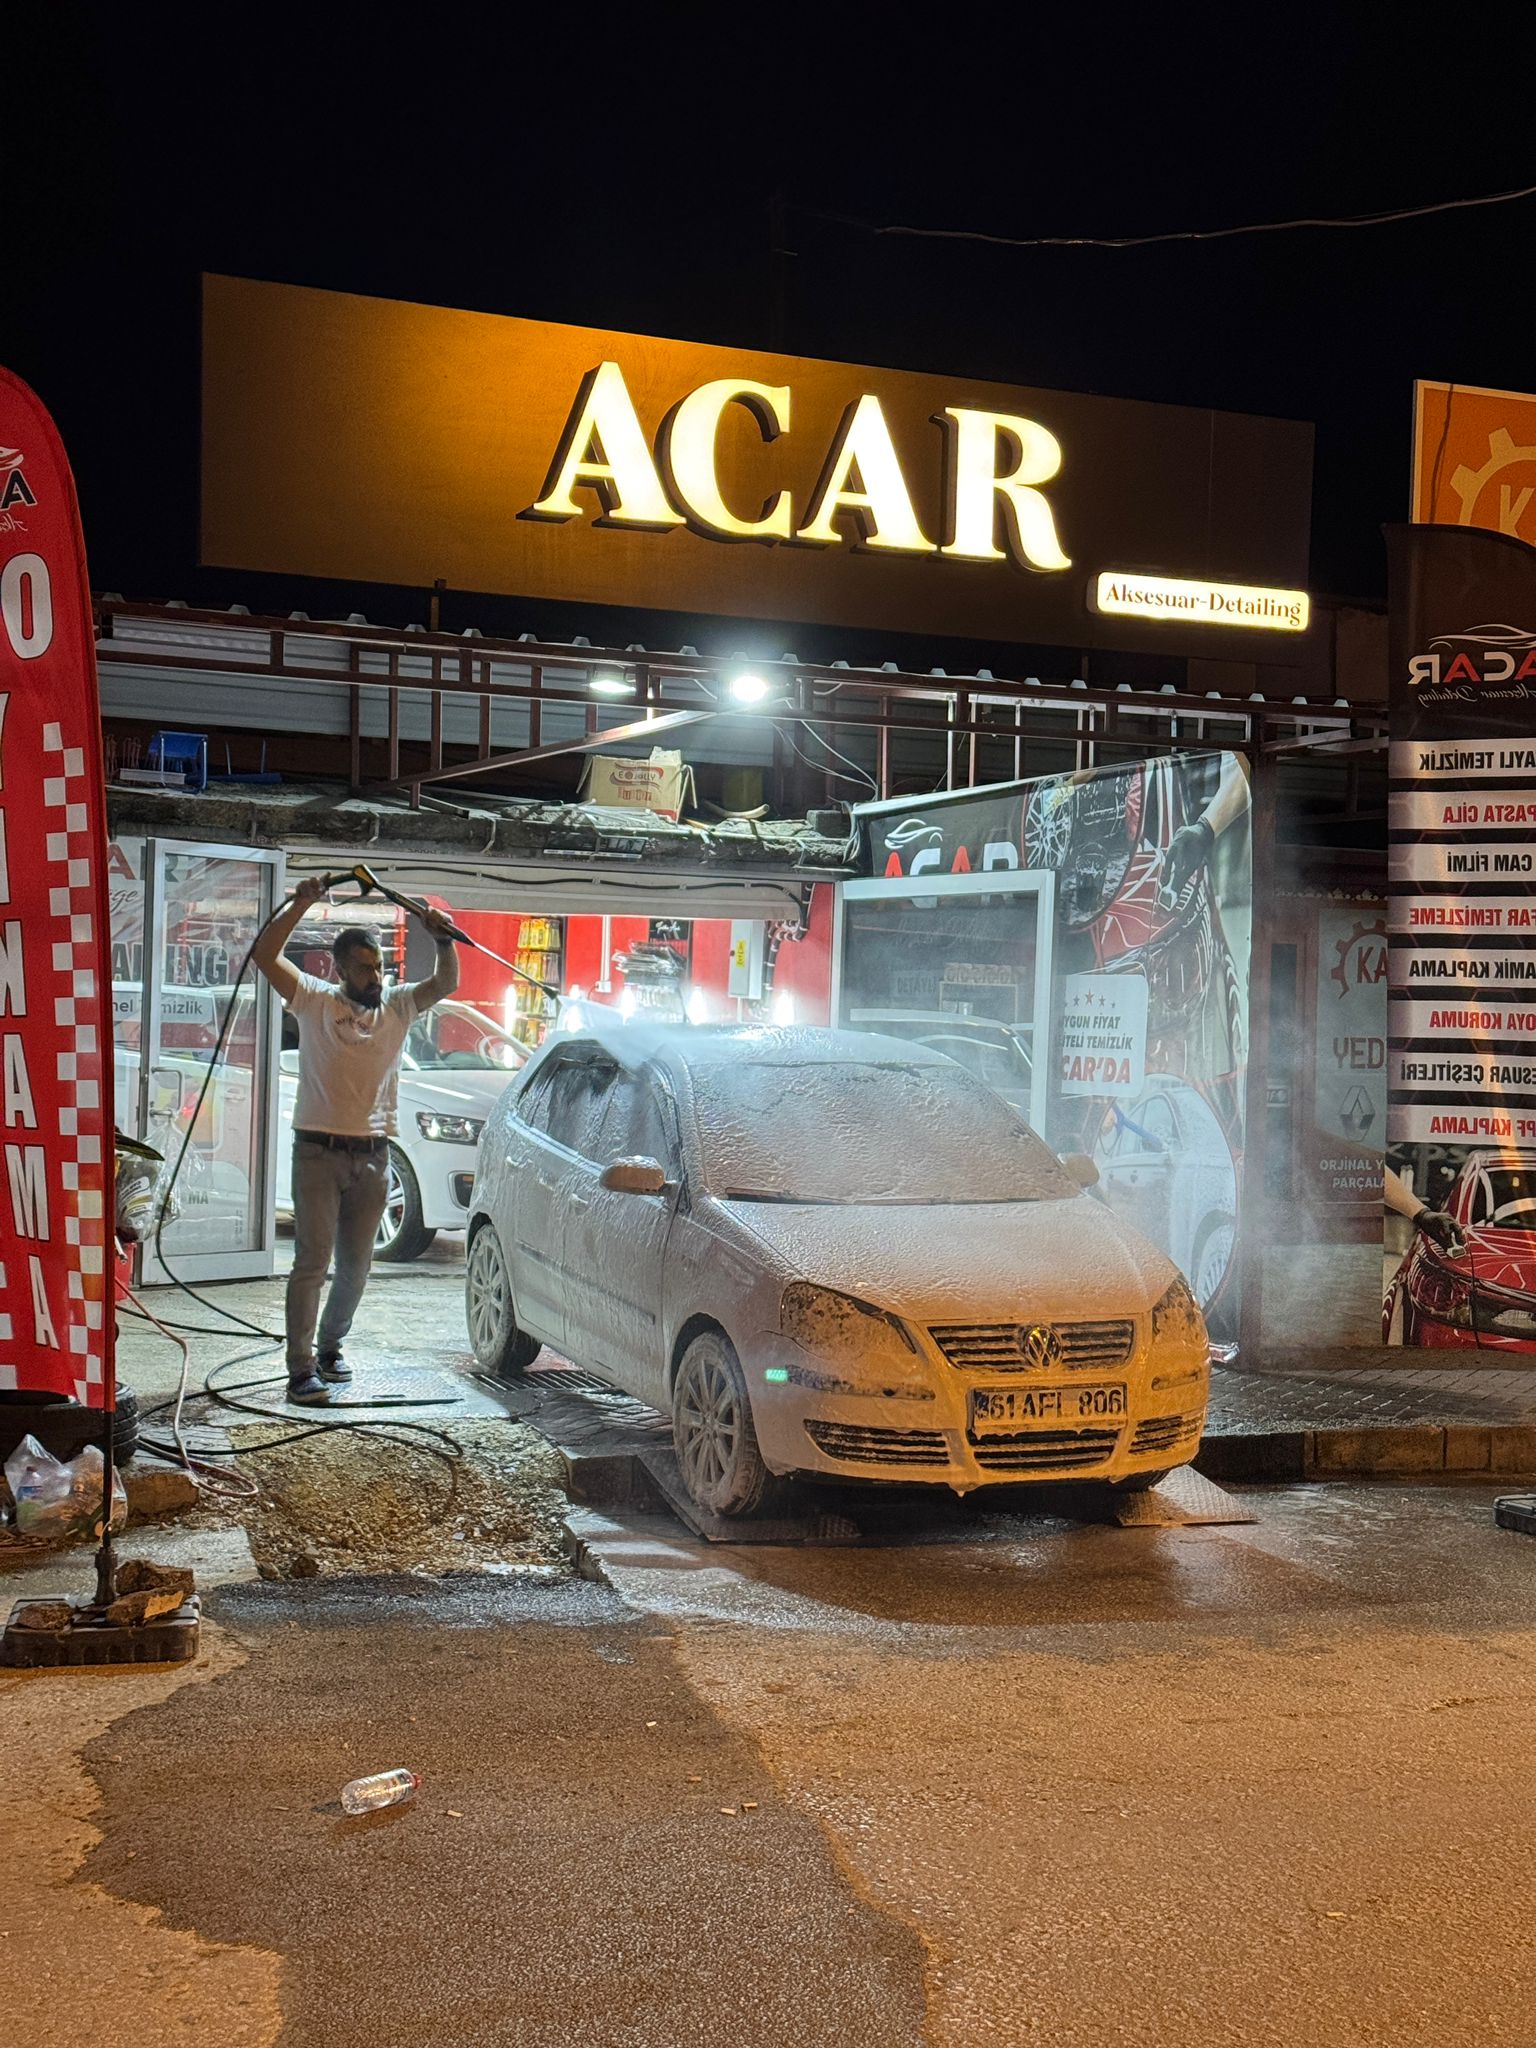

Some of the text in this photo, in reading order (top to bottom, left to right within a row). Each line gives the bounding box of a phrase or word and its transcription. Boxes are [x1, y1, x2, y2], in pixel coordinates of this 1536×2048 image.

[531, 359, 1072, 571] ACAR
[1106, 582, 1301, 626] Aksesuar-Detailing
[1092, 1012, 1121, 1029] FİYAT
[1086, 1033, 1133, 1050] TEMİZLİK
[989, 1393, 1015, 1420] 61
[1079, 1388, 1122, 1416] 806
